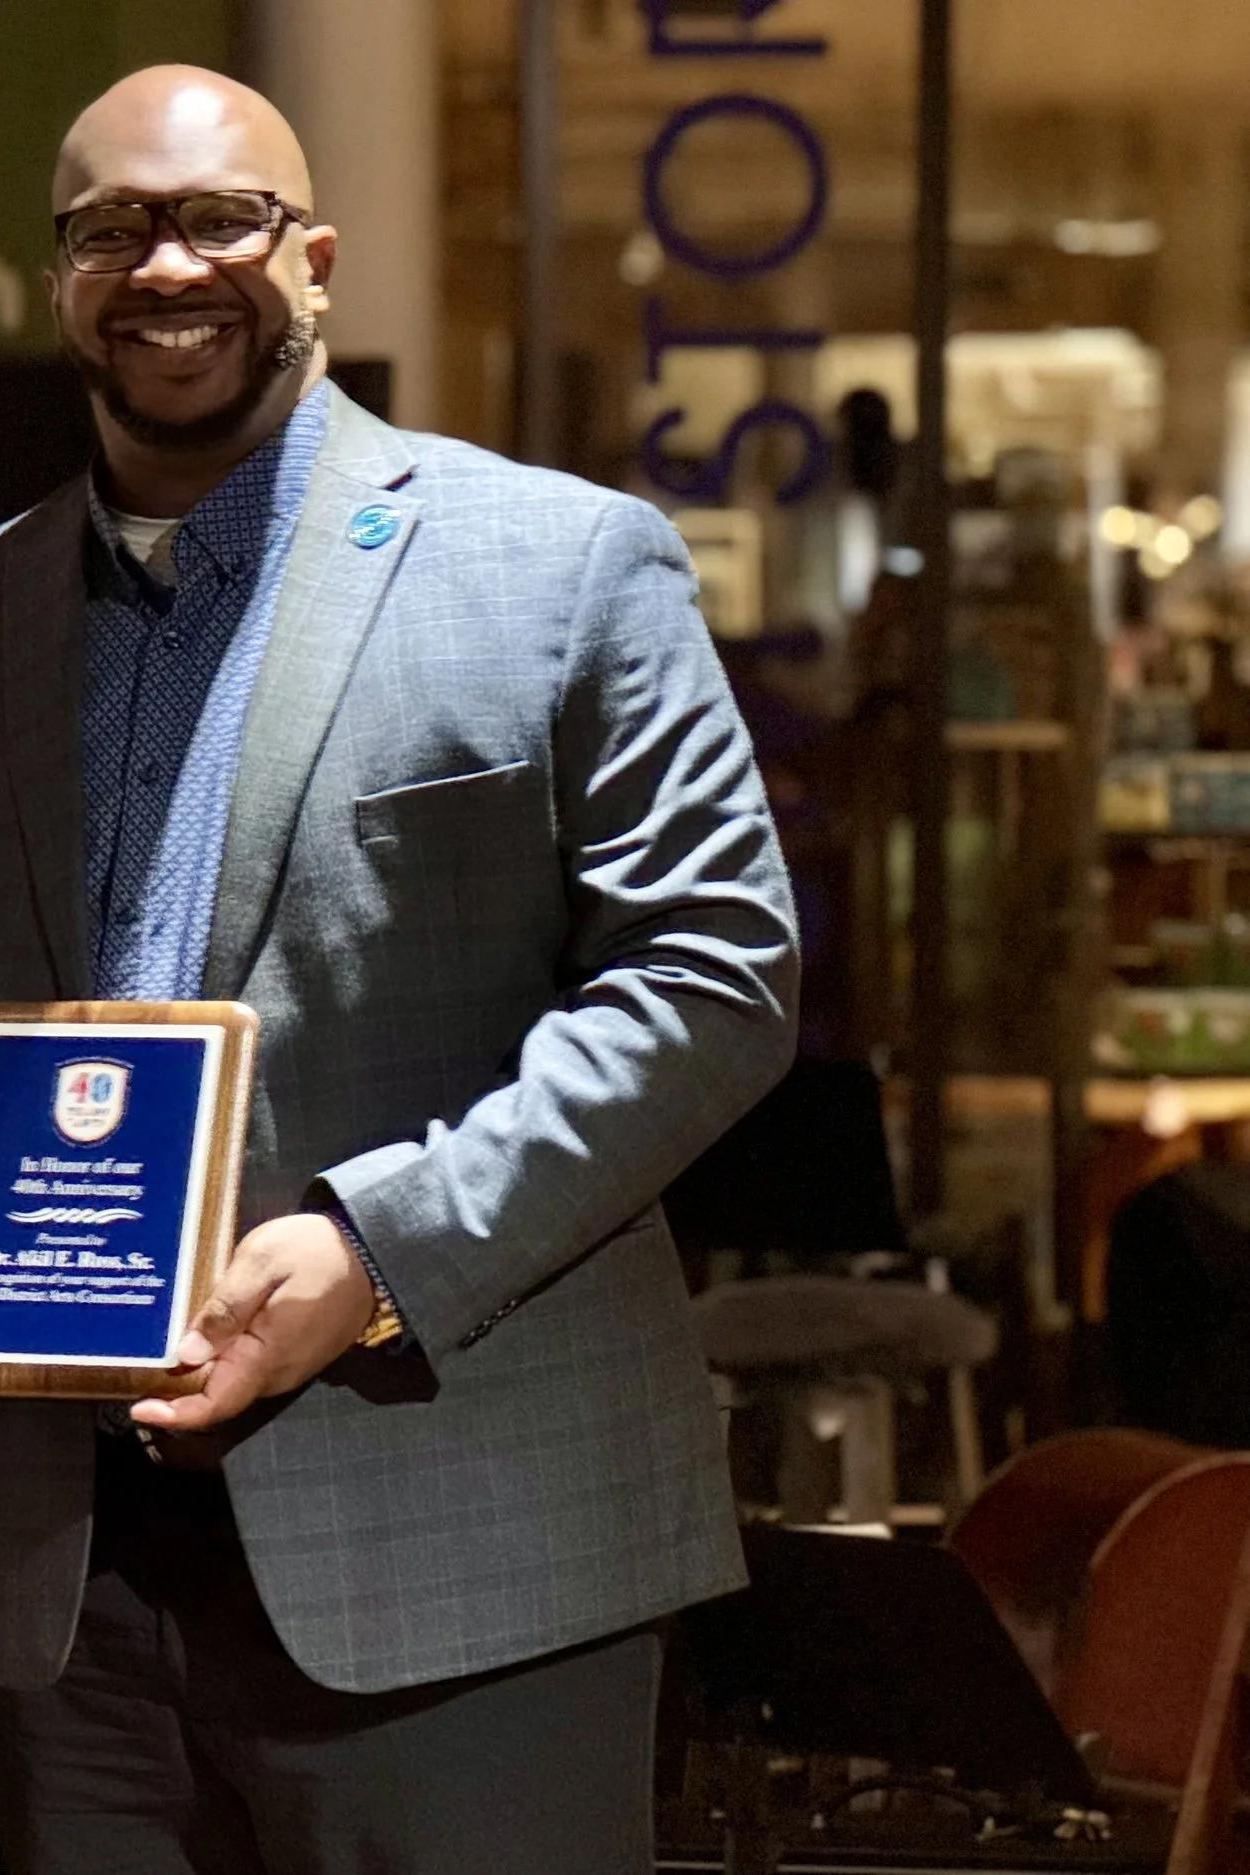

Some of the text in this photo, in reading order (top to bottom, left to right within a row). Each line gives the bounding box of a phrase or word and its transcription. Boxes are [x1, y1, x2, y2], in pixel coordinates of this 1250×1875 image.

[68, 1072, 112, 1104] 40
[55, 1250, 76, 1268] E.
[127, 1252, 155, 1270] Sr.
